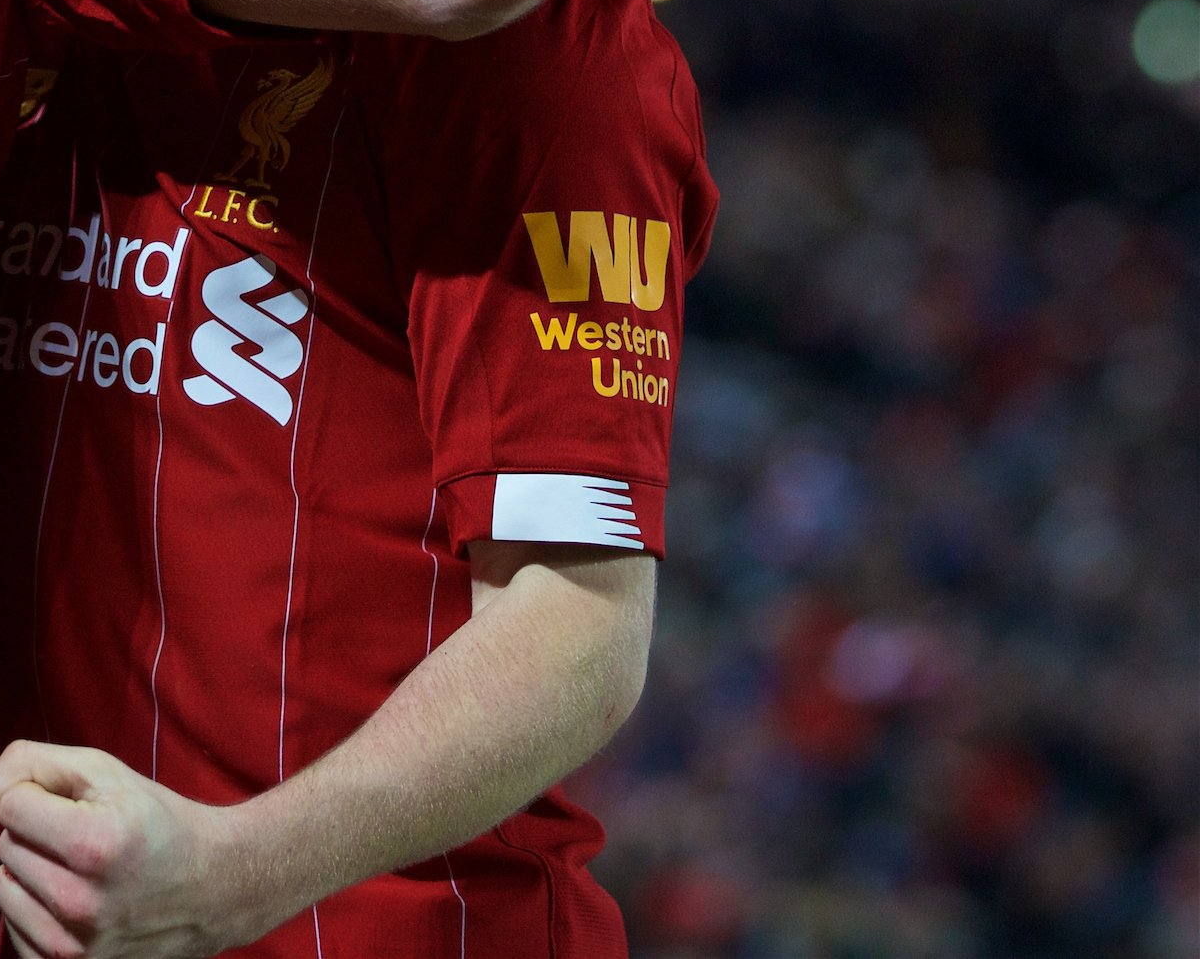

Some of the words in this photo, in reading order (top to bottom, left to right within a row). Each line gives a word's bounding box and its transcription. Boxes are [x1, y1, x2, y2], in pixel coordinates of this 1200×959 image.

[194, 185, 279, 233] L.F.C.
[522, 211, 671, 311] WU
[529, 312, 670, 360] Western
[591, 357, 669, 407] Union
